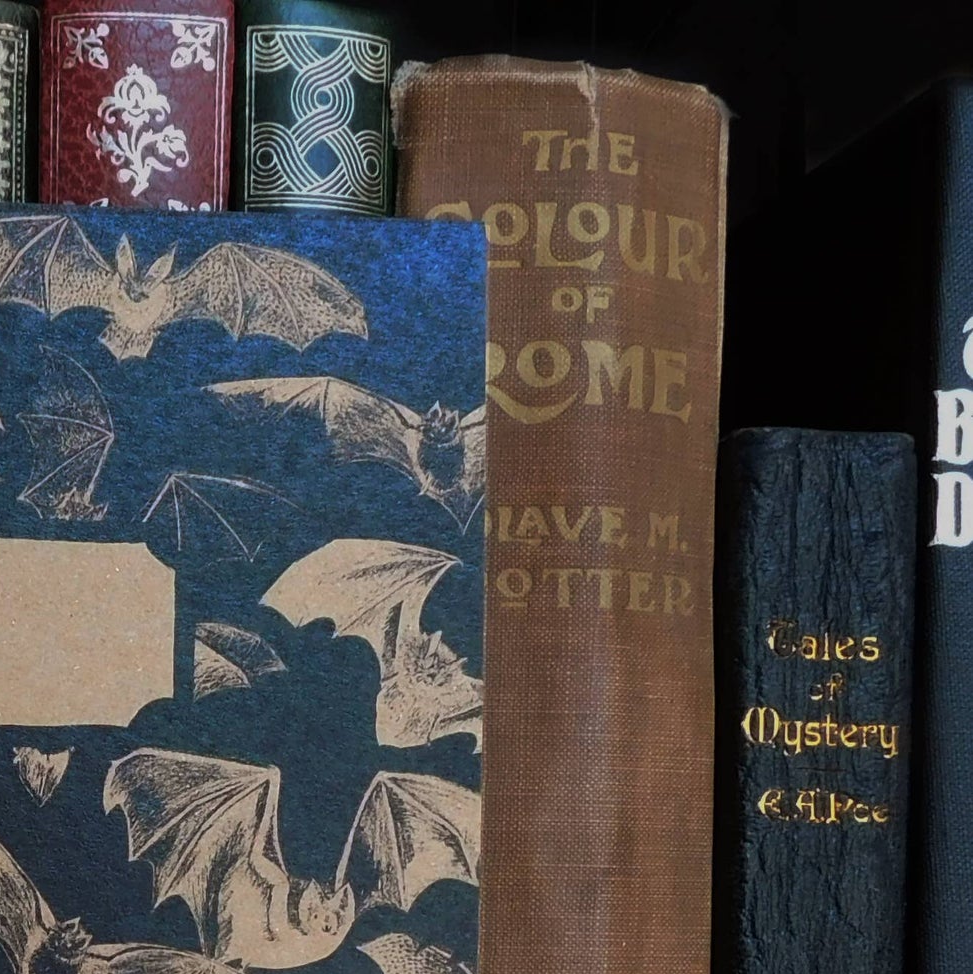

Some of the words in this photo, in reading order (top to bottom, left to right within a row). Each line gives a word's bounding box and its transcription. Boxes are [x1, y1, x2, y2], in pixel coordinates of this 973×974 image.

[522, 130, 639, 176] THE
[551, 285, 614, 324] OF
[485, 505, 628, 549] LAVE
[647, 512, 690, 550] M.
[485, 568, 695, 616] OTTER
[766, 618, 880, 662] Tales
[809, 672, 844, 701] of
[741, 706, 900, 759] Mystery
